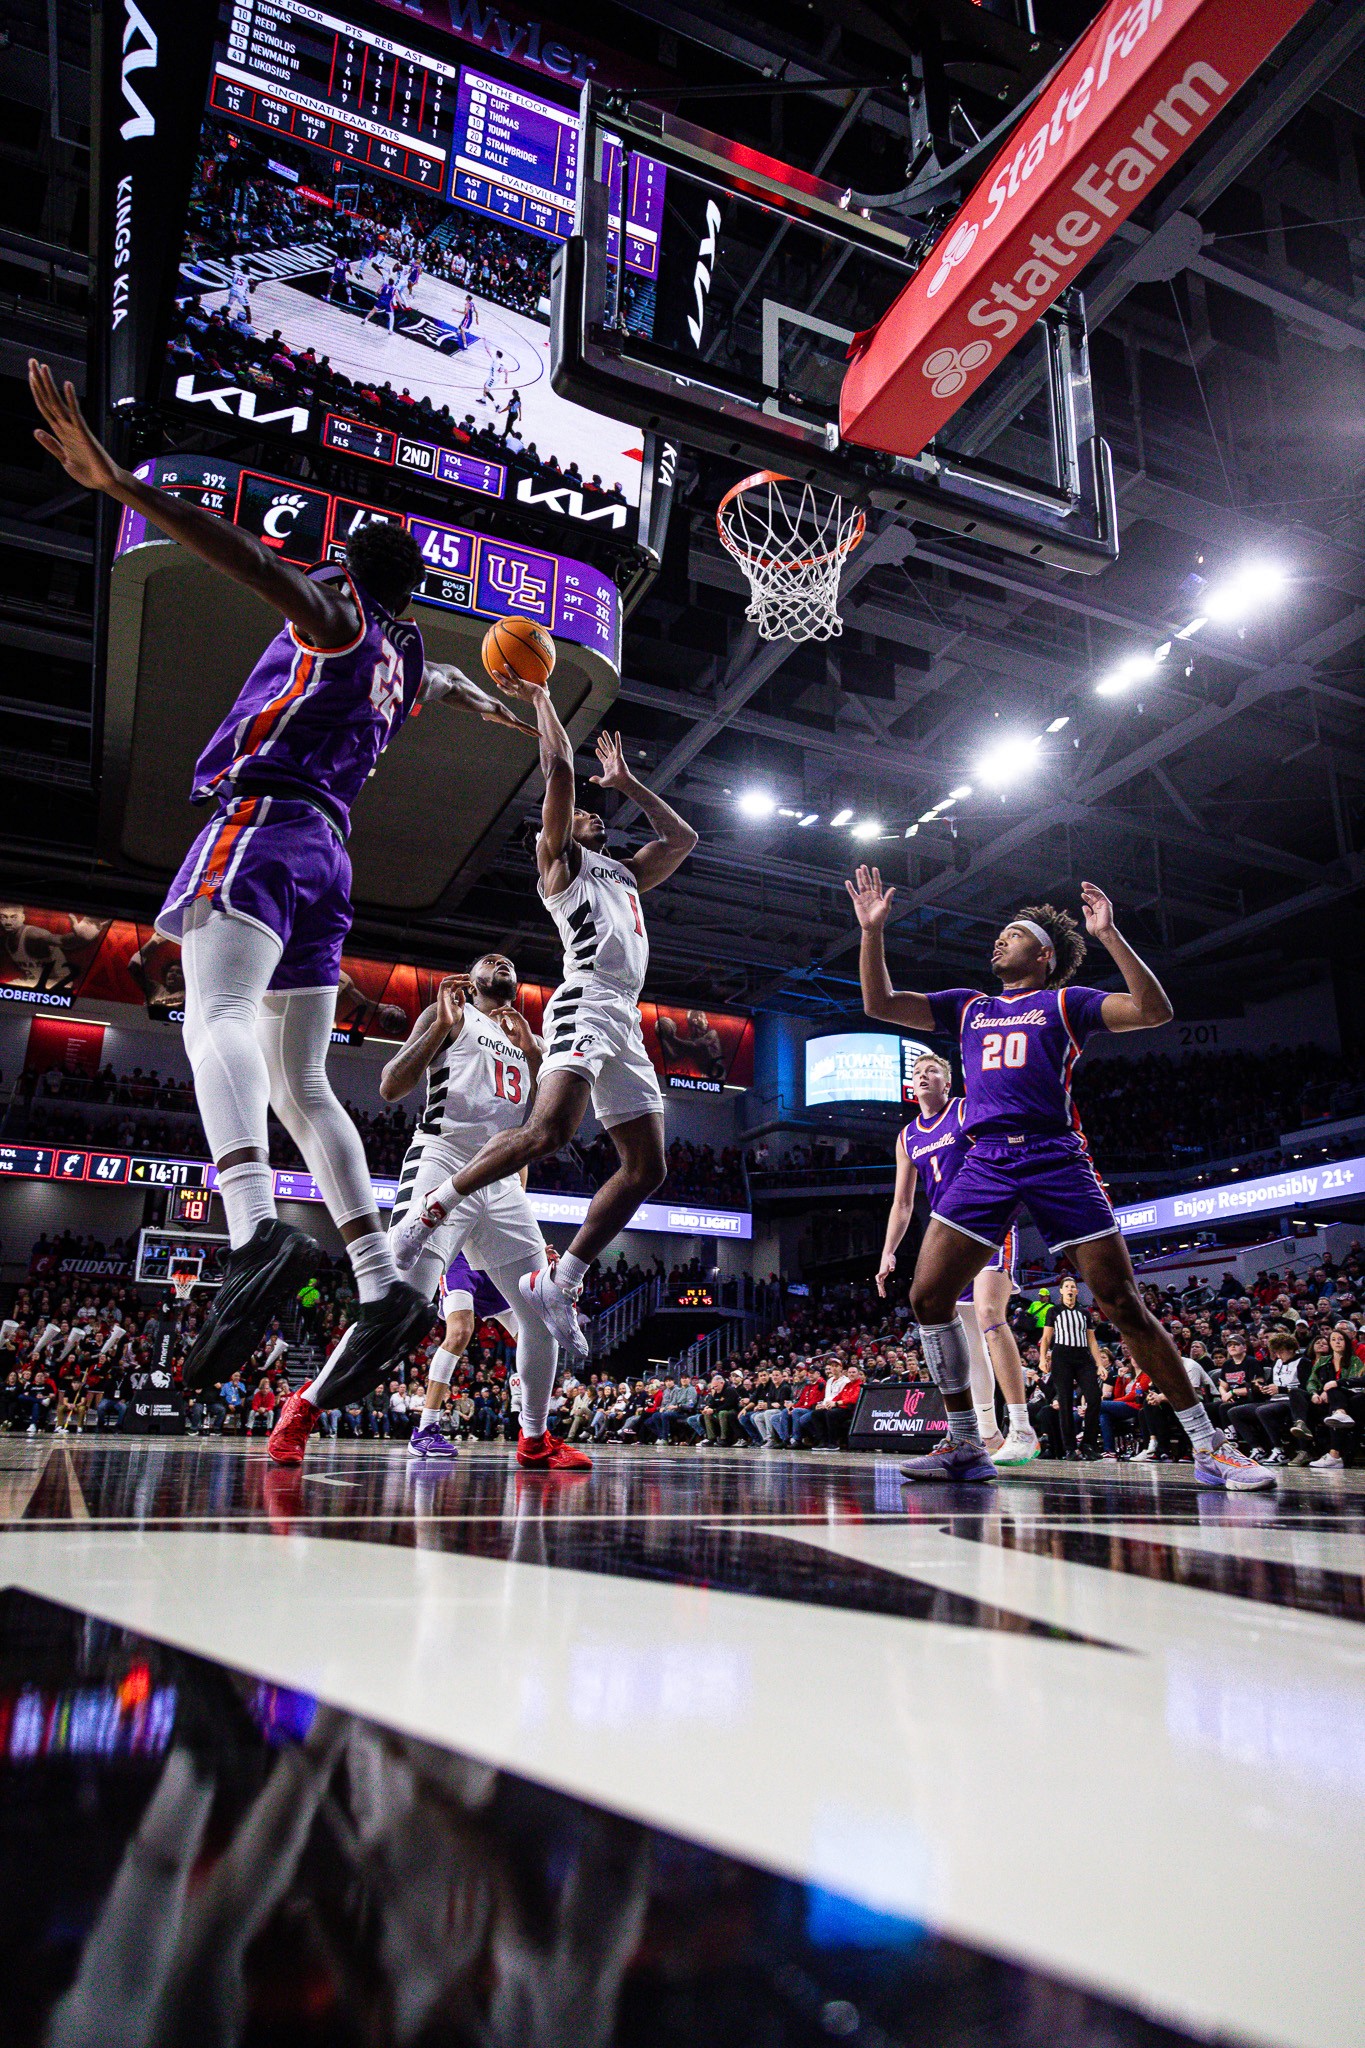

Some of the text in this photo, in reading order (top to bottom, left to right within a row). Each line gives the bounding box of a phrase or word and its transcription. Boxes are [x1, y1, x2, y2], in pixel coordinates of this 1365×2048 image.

[287, 2, 324, 22] FLOOR
[239, 9, 442, 99] 10 REED 0 1 1 2
[256, 2, 443, 86] THOMAS 4 4 6 0
[345, 25, 448, 73] PTS REB AST PF
[449, 0, 598, 83] Wyler
[234, 35, 439, 125] 15 NEWMAN III 11 1 3 1
[236, 21, 440, 112] 13 REYNOLDS 4 2 0 0
[232, 50, 437, 139] 41 LUKOSIUS 9 3 2 1
[476, 79, 548, 115] ON THE FLOOR
[267, 84, 400, 141] CINCINNATI TEAM STATS
[225, 85, 431, 169] AST OREB DREB STL BLK TO
[227, 97, 427, 181] 15 13 17 2 4 7
[490, 98, 510, 112] CUFF
[570, 131, 576, 140] 8
[649, 163, 654, 172] 0
[472, 118, 652, 197] 10 TOUMI 15 1
[489, 111, 520, 130] THOMAS
[569, 143, 575, 153] 2
[647, 175, 653, 184] 0
[469, 144, 649, 222] 22 KALLE 0 1
[470, 131, 650, 209] 20 STRAWBRIDGE 10 1
[501, 174, 558, 204] EVANSVILLE
[464, 176, 645, 251] AST OREB DREB TO
[466, 188, 641, 264] 10 2 15 4
[111, 175, 133, 331] KINGS KIA
[334, 420, 383, 444] TOL 3
[333, 435, 380, 458] FLS 4
[402, 446, 431, 468] 2ND
[444, 454, 491, 476] TOL 2
[658, 442, 678, 488] KIA
[162, 472, 227, 490] FG 39%
[444, 469, 489, 490] FLS 2
[201, 492, 224, 509] 41%
[422, 530, 461, 568] 45
[442, 579, 466, 592] BONUS
[488, 553, 547, 615] UE
[565, 575, 580, 587] FG
[564, 593, 583, 606] 3PT
[563, 612, 575, 622] FT
[625, 890, 643, 938] 1
[970, 1009, 1047, 1030] Evansville
[1180, 1025, 1217, 1045] 201
[836, 1053, 894, 1070] TOWNE
[981, 1031, 1028, 1072] 20
[493, 1058, 522, 1105] 13
[670, 1077, 721, 1093] FINAL FOUR
[0, 1148, 43, 1161] TOL 3
[911, 1132, 956, 1159] Evansville
[33, 1163, 41, 1173] 4
[96, 1157, 121, 1179] 47
[149, 1163, 188, 1184] 14:11
[279, 1174, 295, 1183] TOL
[930, 1155, 942, 1183] 1
[180, 1189, 208, 1201] 14:11
[279, 1187, 316, 1197] FLS 2
[1174, 1168, 1354, 1218] Enjoy Responsibly 21+
[184, 1201, 204, 1220] 18
[670, 1212, 739, 1231] BUD LIGHT
[1120, 1209, 1155, 1228] LIGHT
[58, 1258, 128, 1275] STUDENT
[158, 1334, 170, 1367] Ameritas
[871, 1409, 901, 1419] University of
[873, 1419, 925, 1432] CINCINNATI
